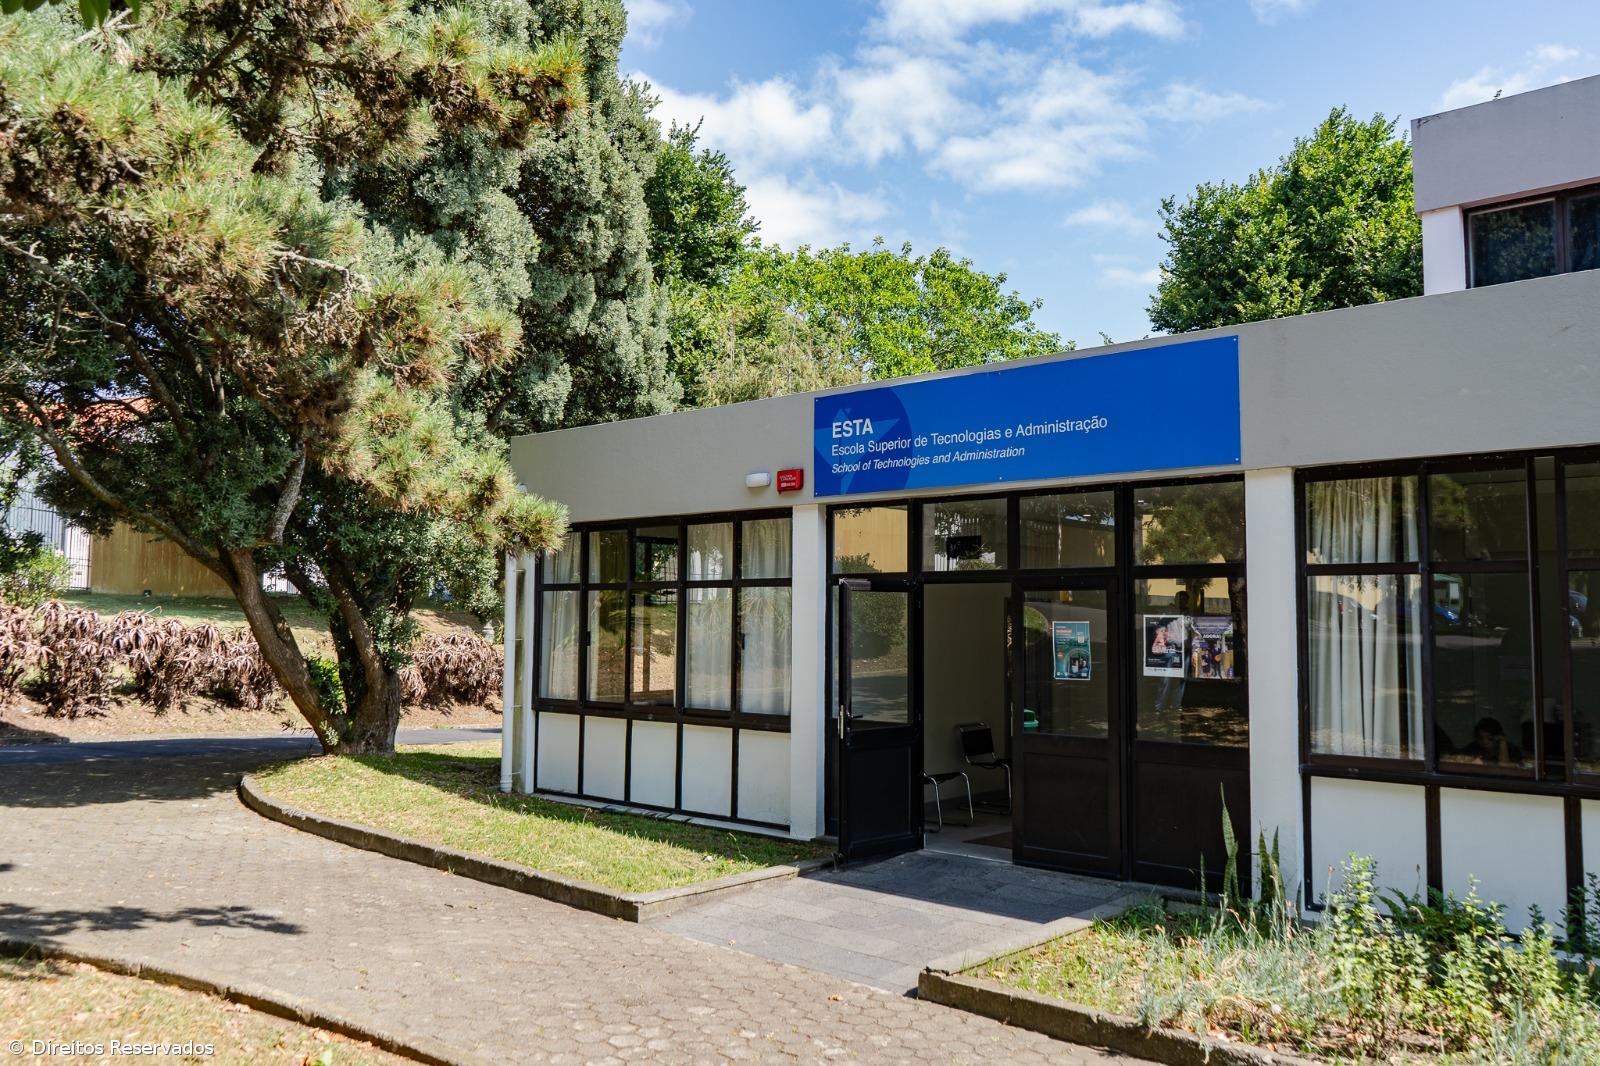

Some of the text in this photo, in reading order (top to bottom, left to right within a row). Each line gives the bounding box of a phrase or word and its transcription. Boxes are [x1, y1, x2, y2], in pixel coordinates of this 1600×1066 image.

[831, 415, 1108, 456] Escola Superior de Tecnologias e Administração
[832, 417, 874, 439] ESTA
[831, 446, 1025, 474] School of Technologies and Administration
